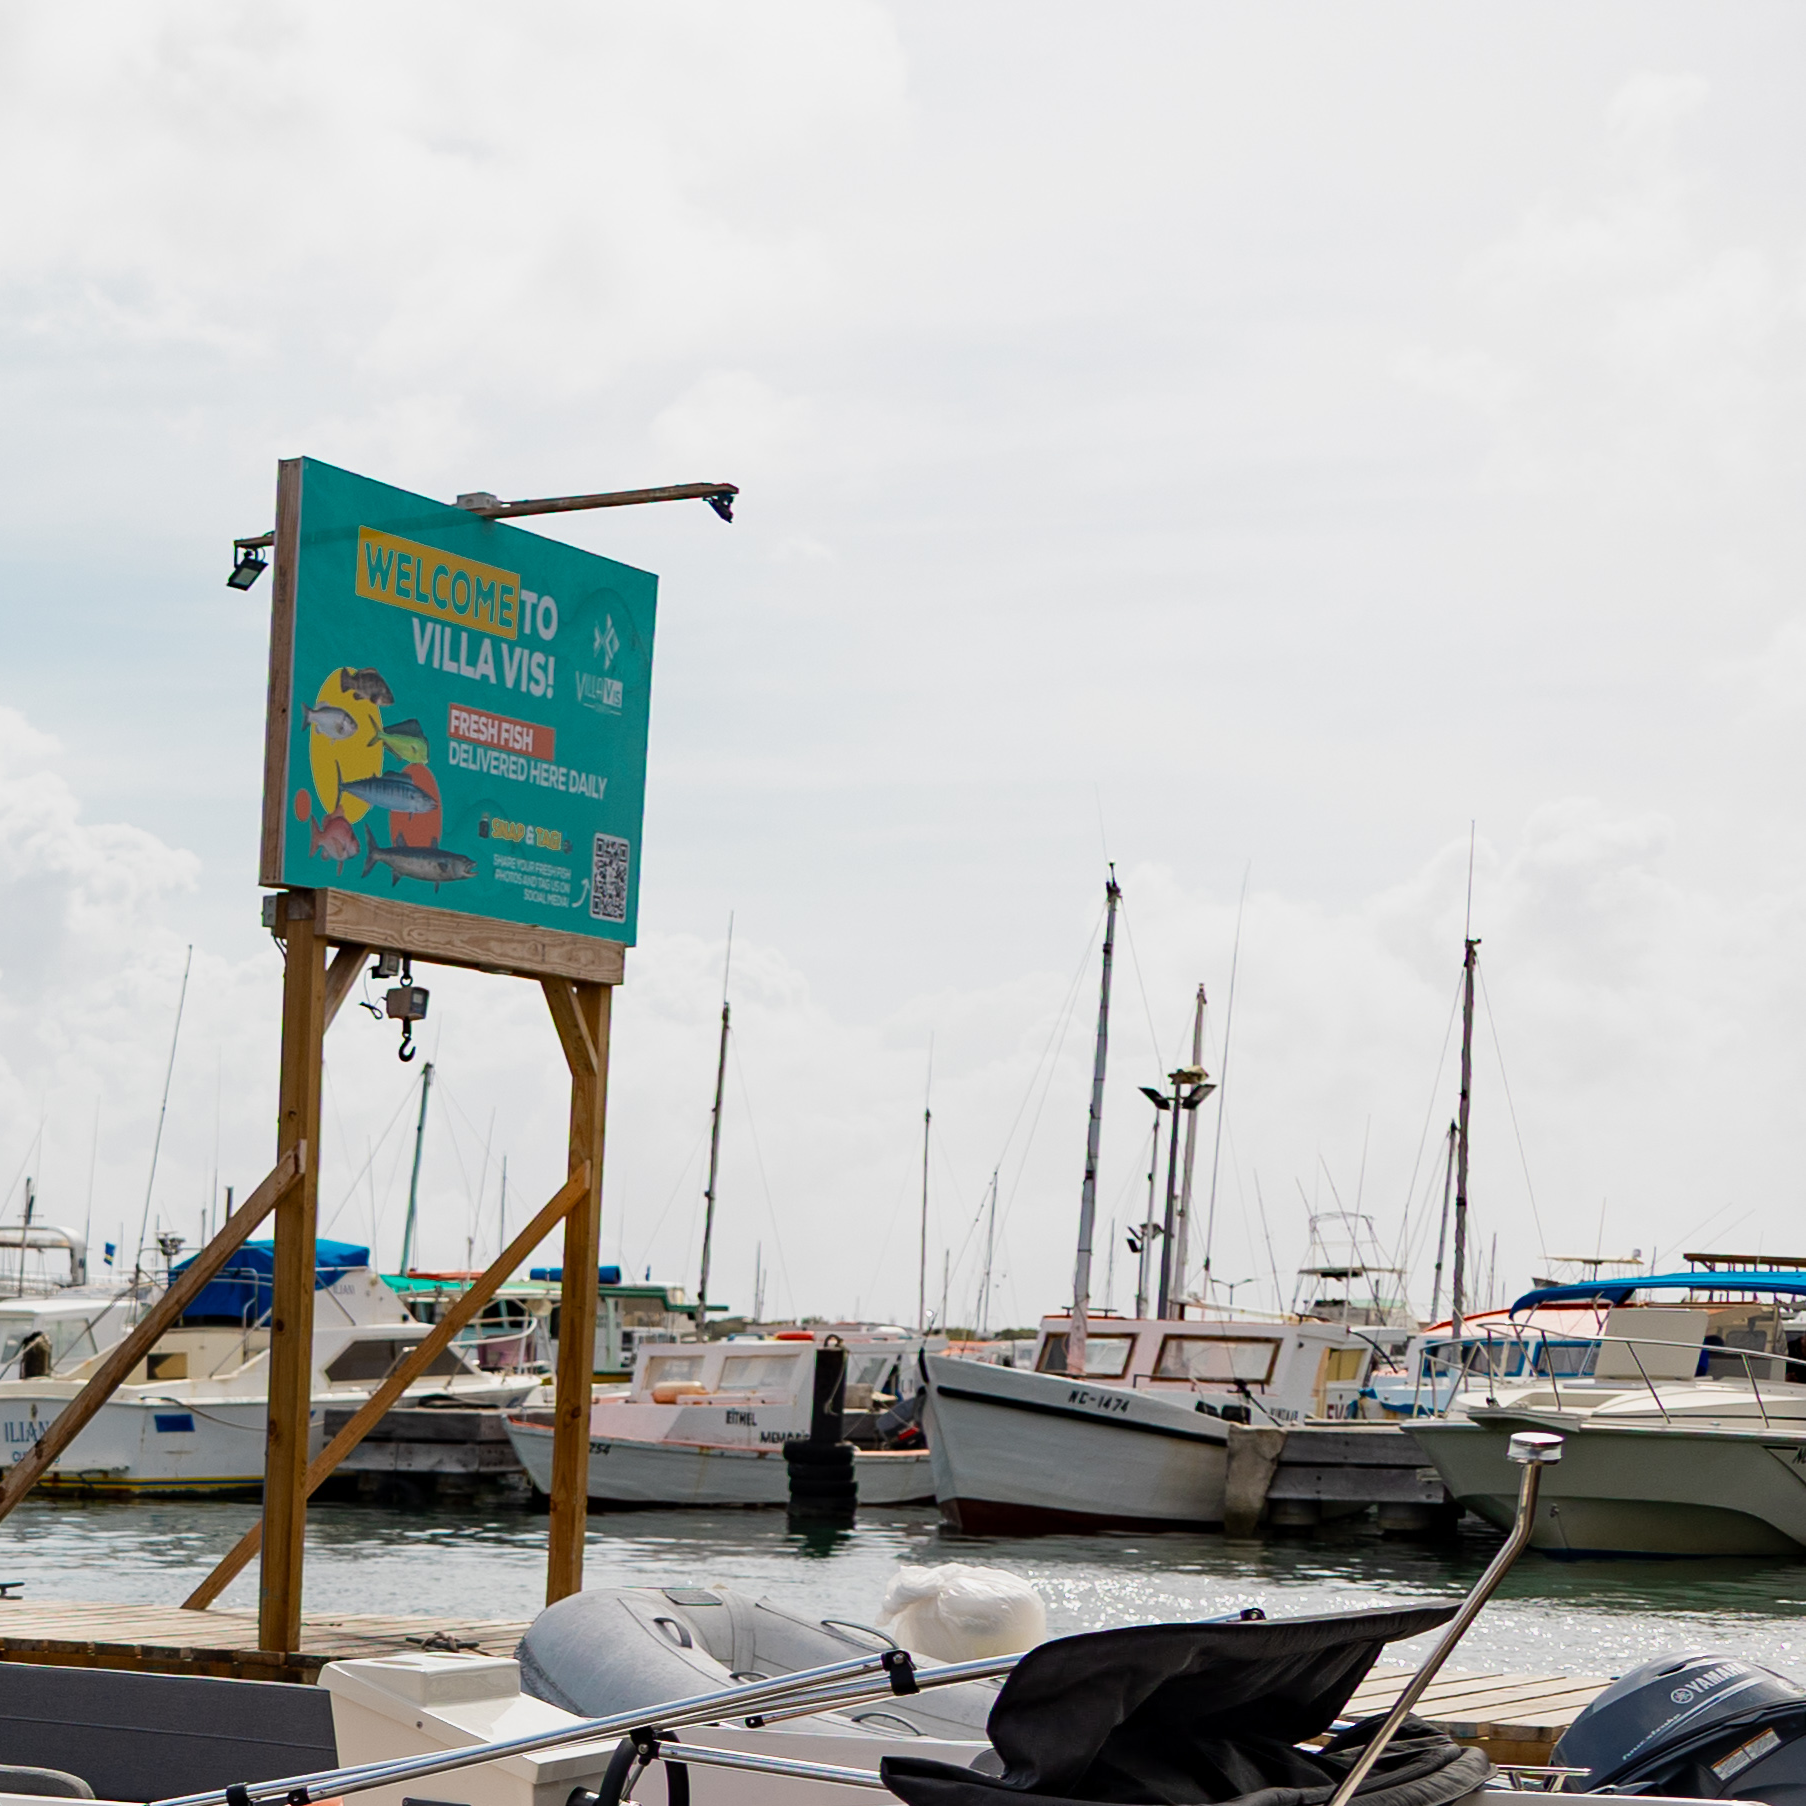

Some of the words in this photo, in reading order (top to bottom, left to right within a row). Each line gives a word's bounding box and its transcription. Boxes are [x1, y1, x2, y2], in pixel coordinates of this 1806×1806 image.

[364, 541, 515, 629] WELCOME
[520, 589, 558, 641] TO
[412, 616, 497, 685] VILLA
[501, 642, 555, 699] VIS!
[450, 709, 498, 744] FRESH
[500, 721, 534, 752] FISH
[448, 740, 528, 782] DELIVERED
[529, 761, 567, 791] HERE
[569, 769, 608, 800] DAILY
[491, 818, 525, 843] SNAP
[525, 825, 534, 845] &
[493, 853, 516, 870] SHARE
[517, 858, 535, 874] YOUR
[494, 868, 523, 885] PHOTOS
[523, 875, 537, 888] AND
[537, 877, 551, 891] TAG
[523, 887, 548, 905] SOCIAL
[1684, 1662, 1752, 1693] YAMAHA
